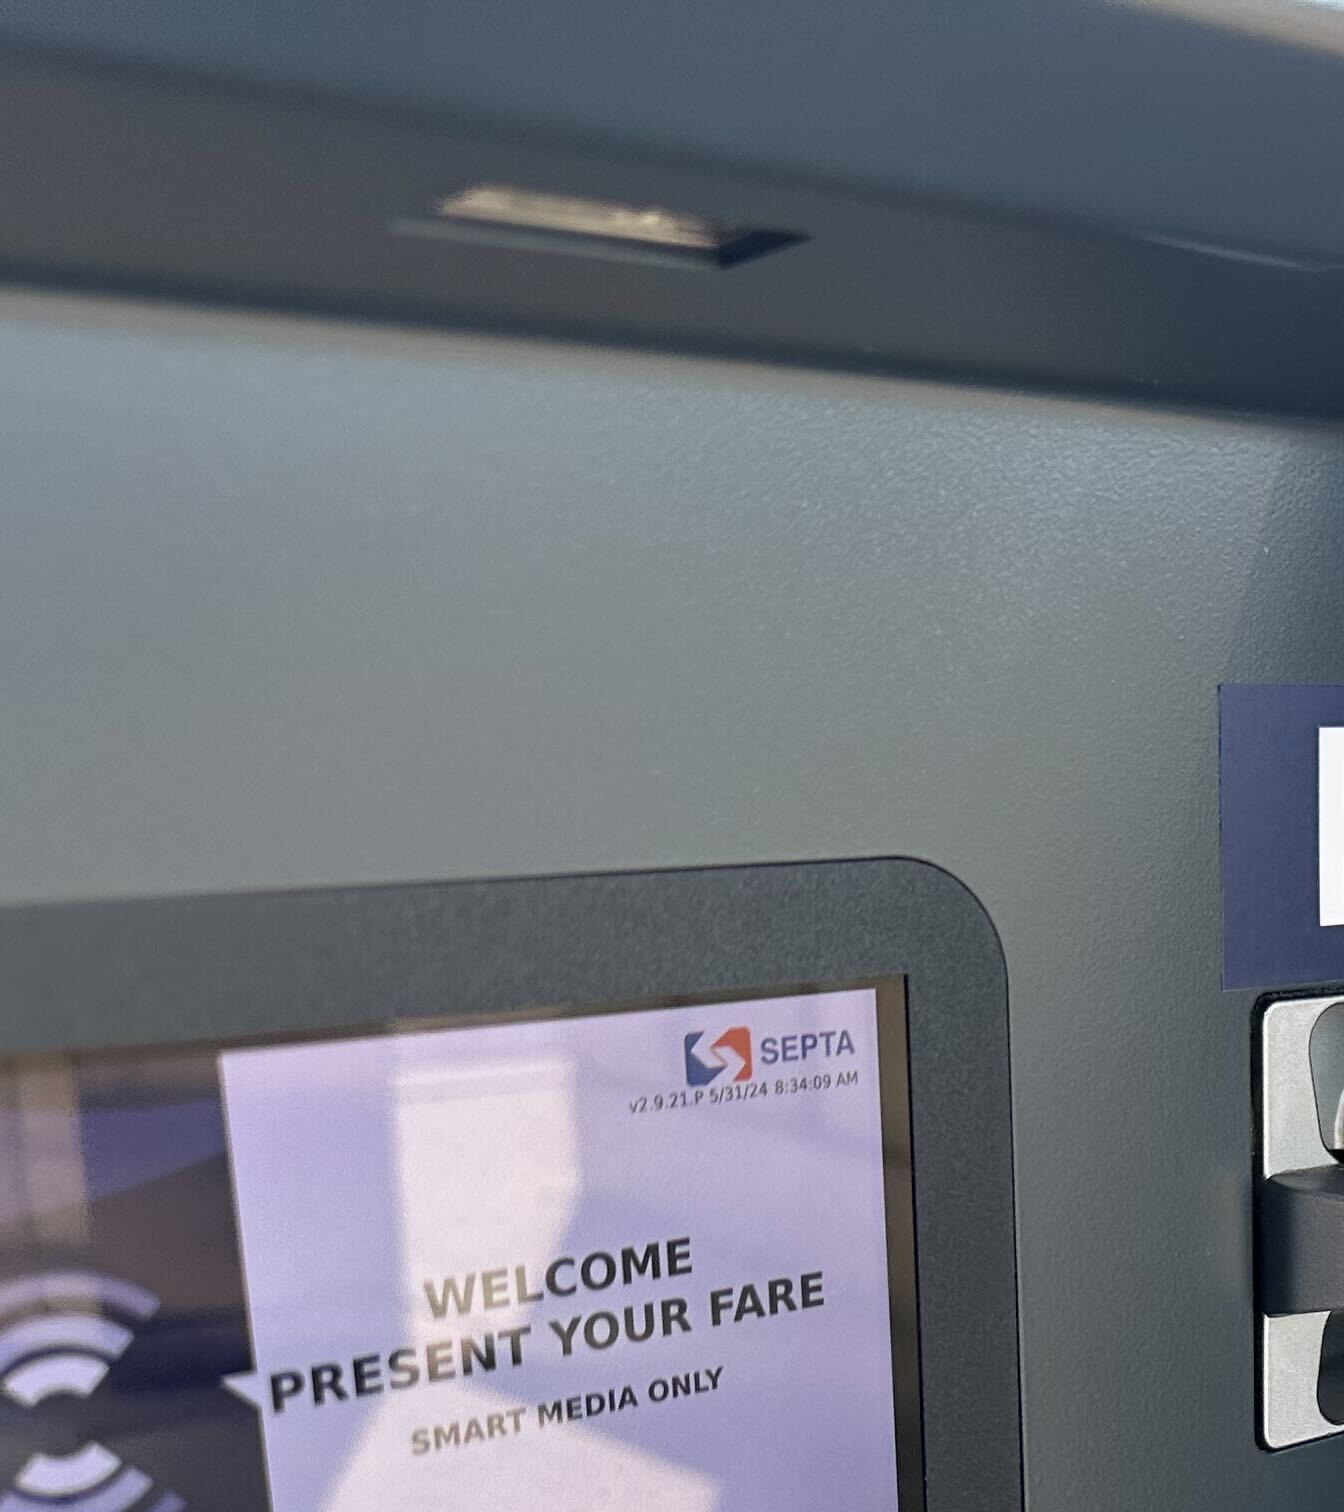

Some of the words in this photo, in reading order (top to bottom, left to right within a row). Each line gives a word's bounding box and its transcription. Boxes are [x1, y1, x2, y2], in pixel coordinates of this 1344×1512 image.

[760, 1030, 855, 1065] SEPTA
[629, 1091, 704, 1114] v2.9.21.P
[709, 1082, 768, 1105] 5/31/24
[774, 1074, 832, 1096] 8:34:09
[835, 1071, 859, 1087] AM
[423, 1237, 693, 1320] WELCOME
[268, 1325, 532, 1414] PRESENT
[548, 1298, 692, 1358] YOUR
[709, 1271, 826, 1328] FARE
[410, 1407, 527, 1456] SMART
[537, 1385, 639, 1428] MEDIA
[647, 1365, 724, 1404] ONLY
